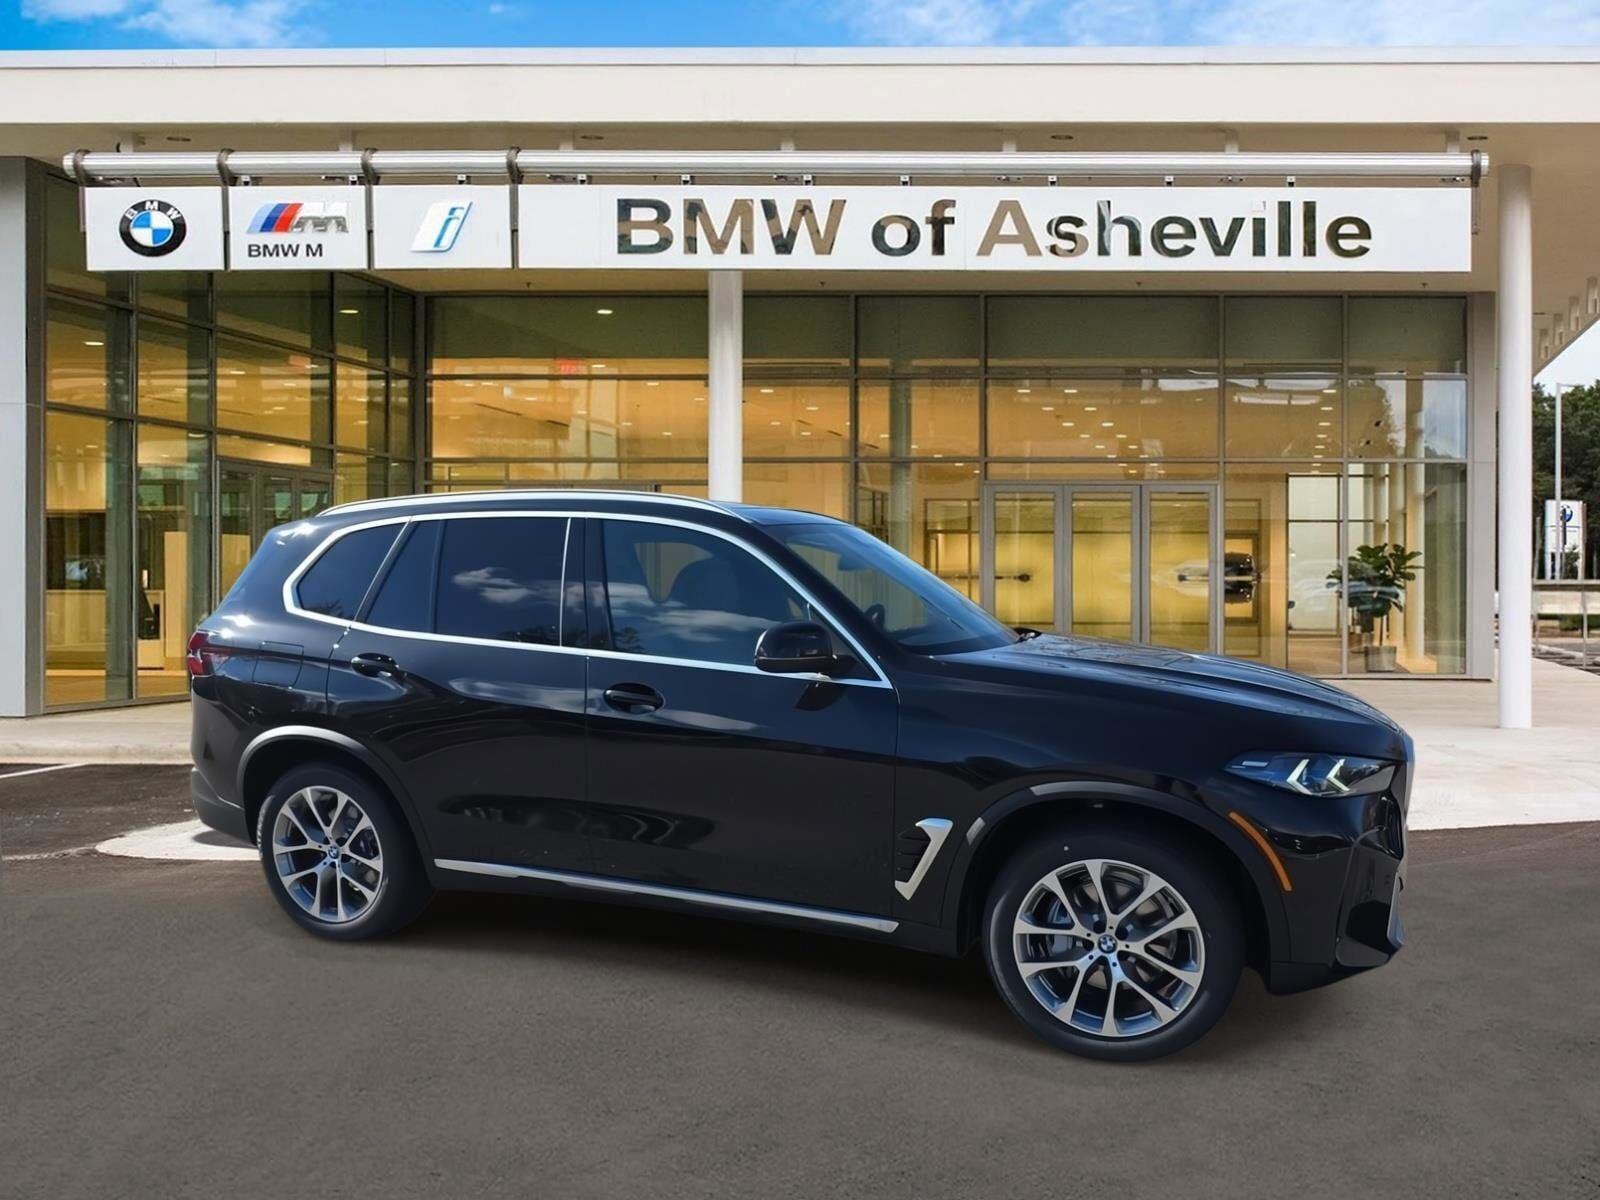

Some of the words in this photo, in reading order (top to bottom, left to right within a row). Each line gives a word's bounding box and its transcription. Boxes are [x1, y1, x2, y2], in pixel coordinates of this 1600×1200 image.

[124, 200, 182, 220] BMW
[616, 198, 847, 255] BMW
[871, 199, 957, 257] of
[975, 199, 1373, 258] Asheville
[247, 243, 301, 258] BMW
[305, 243, 324, 258] M
